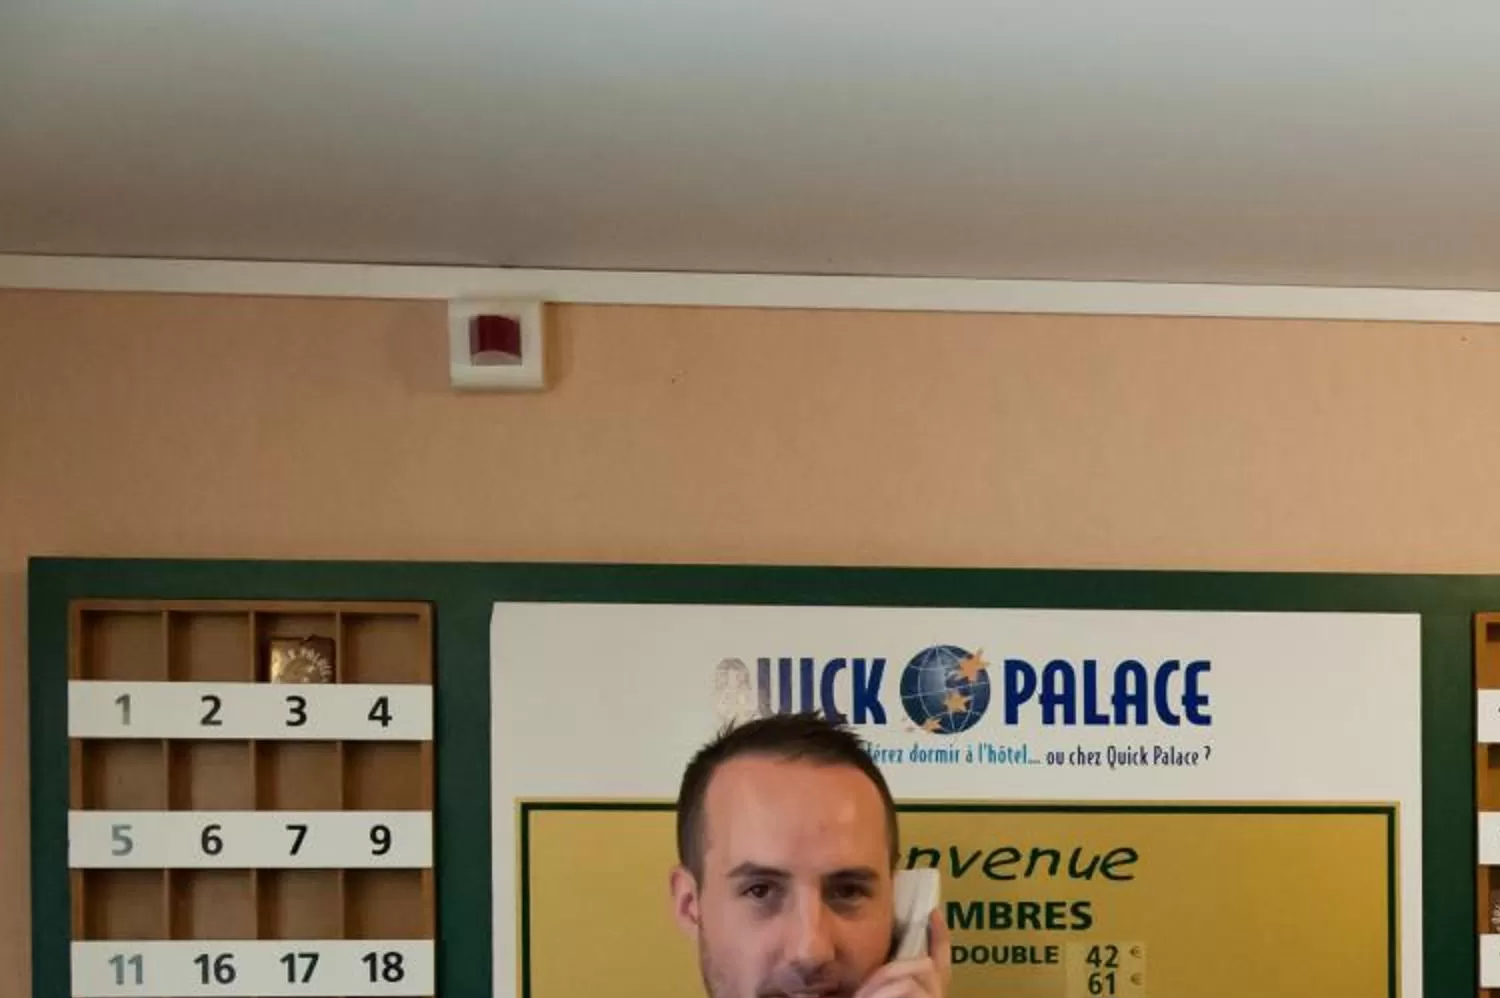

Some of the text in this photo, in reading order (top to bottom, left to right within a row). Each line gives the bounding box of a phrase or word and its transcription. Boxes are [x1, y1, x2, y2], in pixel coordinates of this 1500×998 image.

[715, 658, 1212, 727] QUICK PALACE
[114, 694, 392, 728] 1 2 3 4
[910, 742, 960, 765] dormir
[1047, 751, 1064, 766] ou
[1069, 745, 1100, 766] chez
[1107, 745, 1150, 768] Quick
[1153, 746, 1199, 766] Palace
[112, 824, 392, 856] 5 6 7 9
[906, 845, 1138, 880] nvenue
[947, 901, 1093, 930] MBRES
[108, 951, 404, 985] 11 16 17 18
[951, 946, 1059, 964] DOUBLE
[1085, 945, 1119, 968] 42
[1088, 972, 1116, 995] 61
